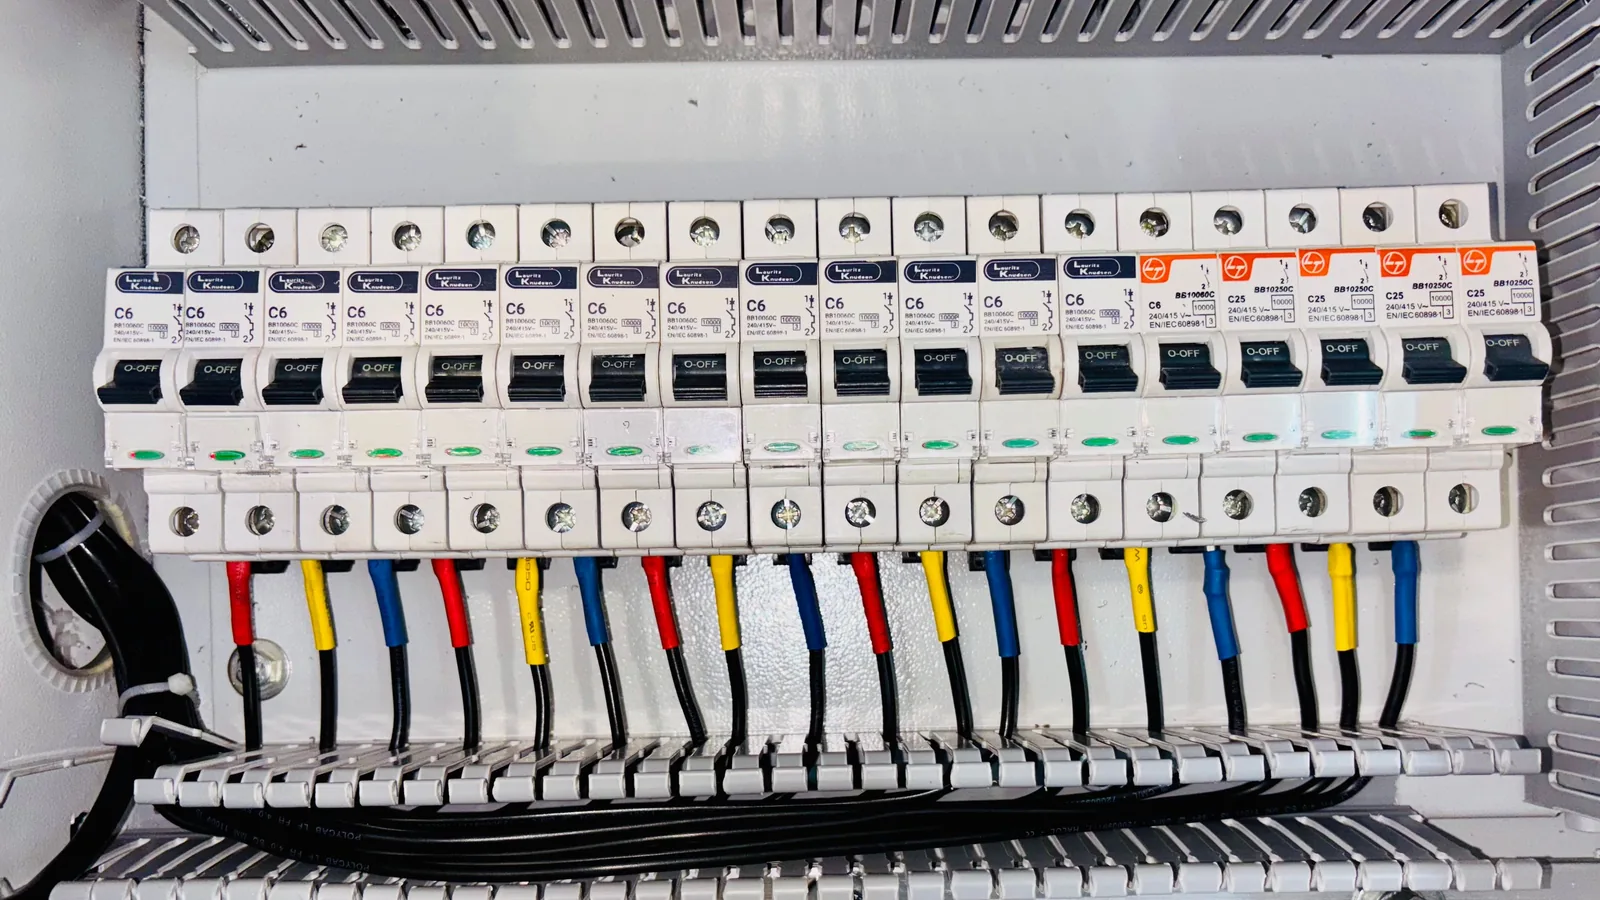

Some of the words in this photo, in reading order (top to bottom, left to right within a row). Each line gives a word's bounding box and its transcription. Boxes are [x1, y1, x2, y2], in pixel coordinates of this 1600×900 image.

[1080, 268, 1111, 276] Knudsen
[441, 280, 472, 288] Knudsen
[521, 278, 552, 286] Knudsen
[603, 277, 634, 285] Knudsen
[682, 277, 713, 285] Knudsen
[284, 283, 316, 291] Knudsen
[363, 283, 394, 291] Knudsen
[1066, 294, 1084, 305] C6
[1228, 295, 1246, 303] C25
[1308, 295, 1325, 303] C25
[1386, 292, 1404, 300] C25
[747, 300, 765, 311] C6
[825, 298, 844, 309] C6
[905, 298, 924, 309] C6
[984, 296, 1002, 308] C6
[115, 308, 133, 319] C6
[186, 307, 204, 318] C6
[269, 307, 287, 318] C6
[348, 307, 365, 318] C6
[425, 305, 444, 316] C6
[506, 303, 525, 314] C6
[588, 303, 606, 314] C6
[668, 302, 686, 314] C6
[315, 826, 361, 841] POLYCAB
